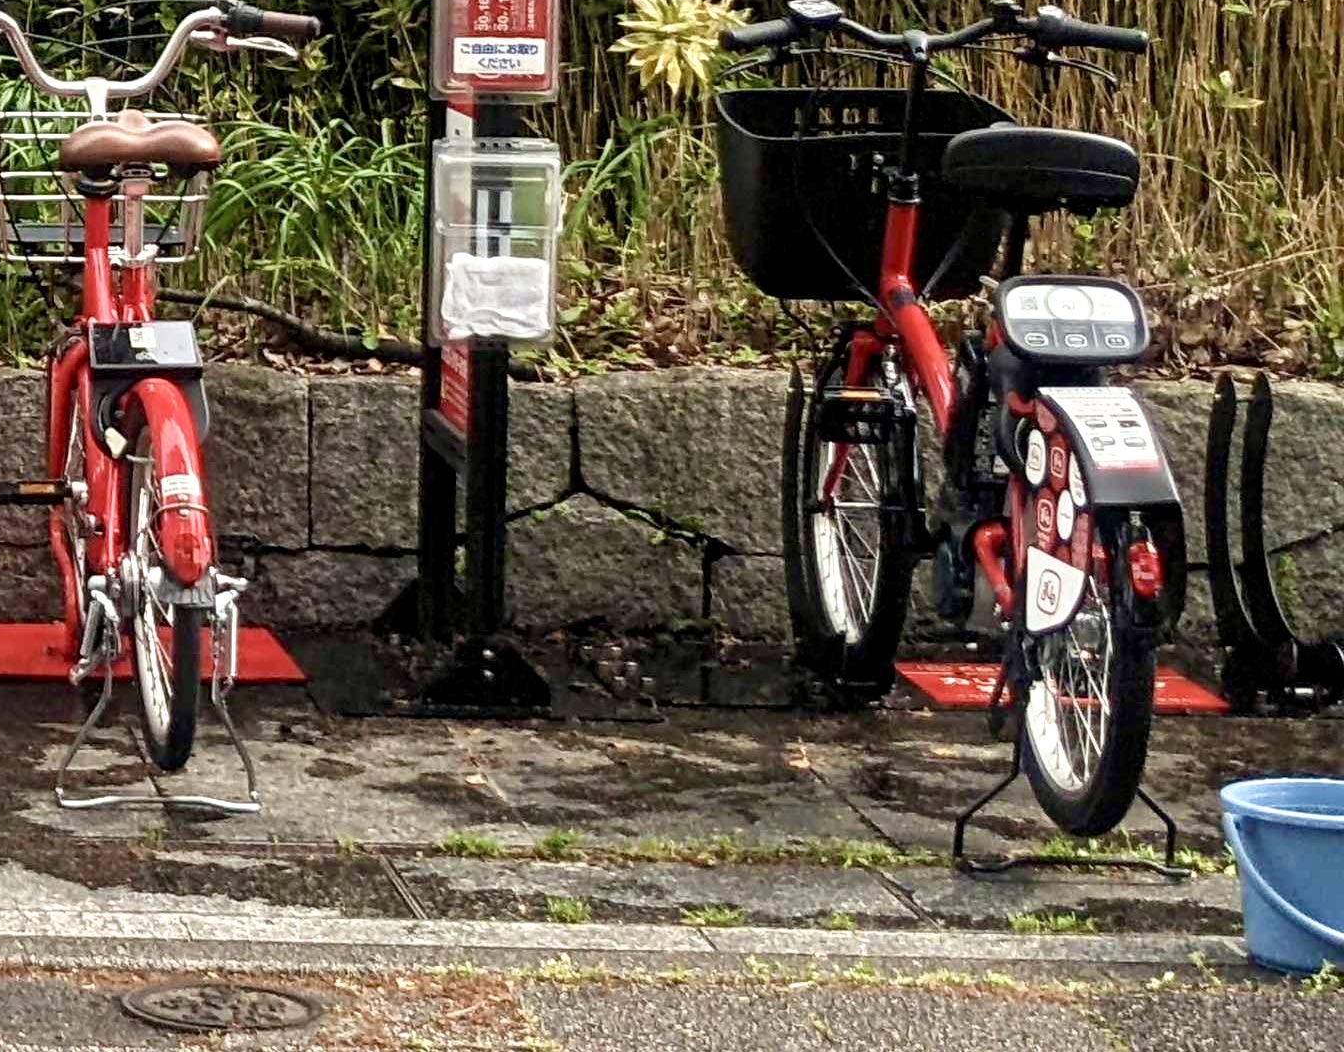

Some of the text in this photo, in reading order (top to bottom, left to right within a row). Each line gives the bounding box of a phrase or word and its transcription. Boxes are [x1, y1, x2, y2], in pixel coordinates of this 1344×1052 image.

[460, 43, 538, 55] ご自由にお取り
[478, 59, 521, 69] ください
